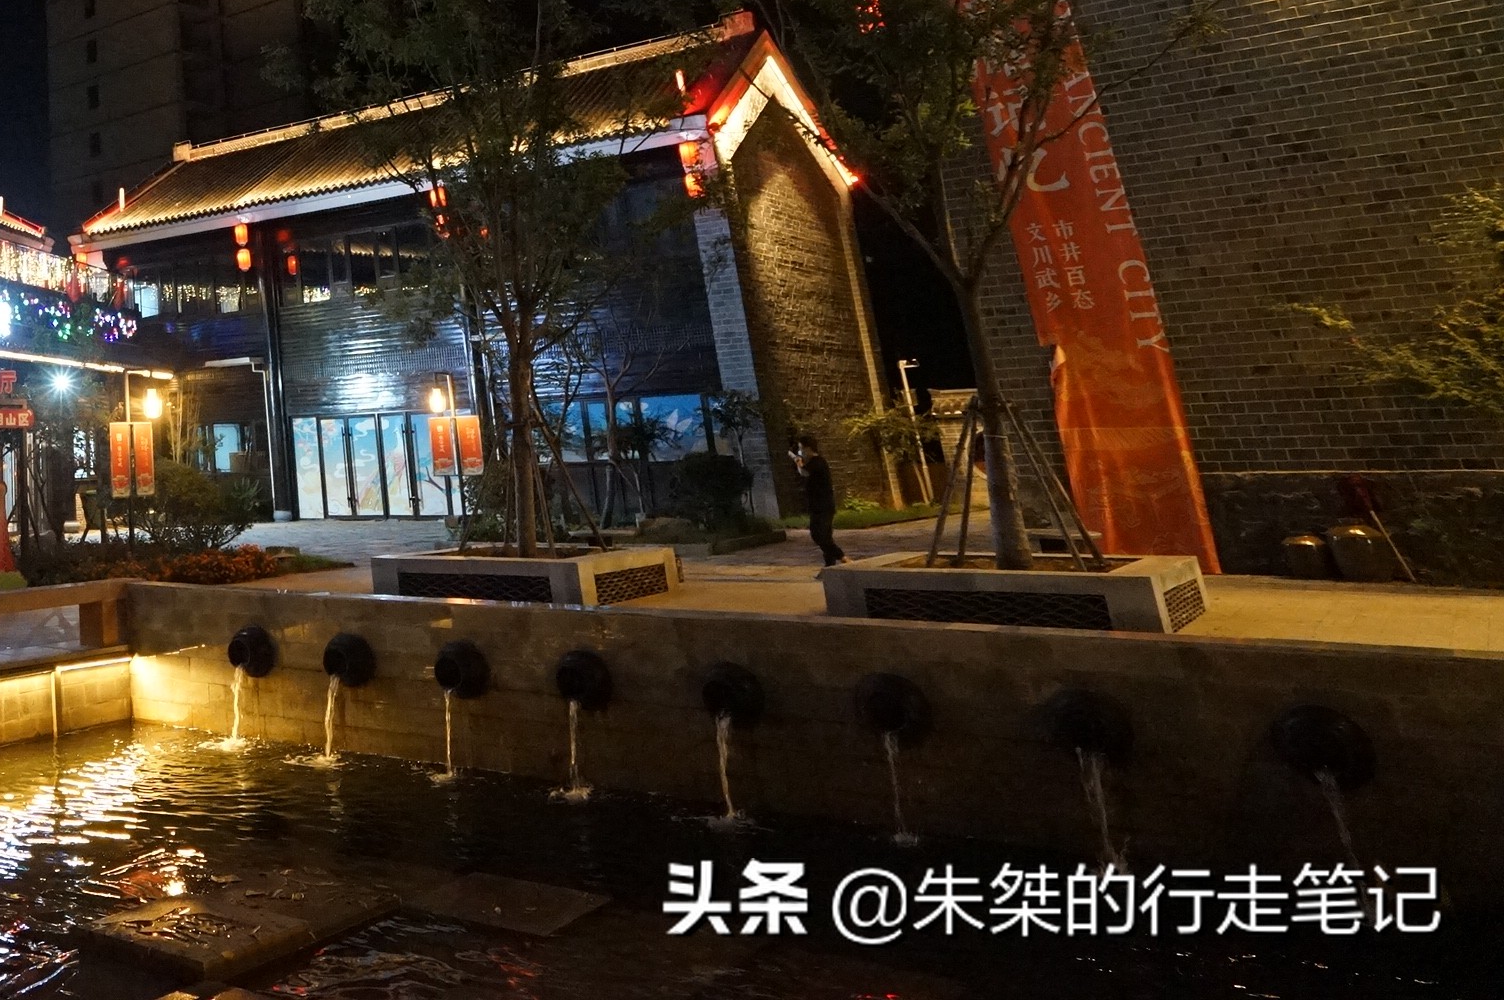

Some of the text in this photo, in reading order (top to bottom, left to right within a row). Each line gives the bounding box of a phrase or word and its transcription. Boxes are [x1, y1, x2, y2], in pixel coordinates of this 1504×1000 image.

[1026, 222, 1062, 314] 文川武乡
[1052, 219, 1096, 310] 市井百态
[1118, 259, 1170, 352] CITY
